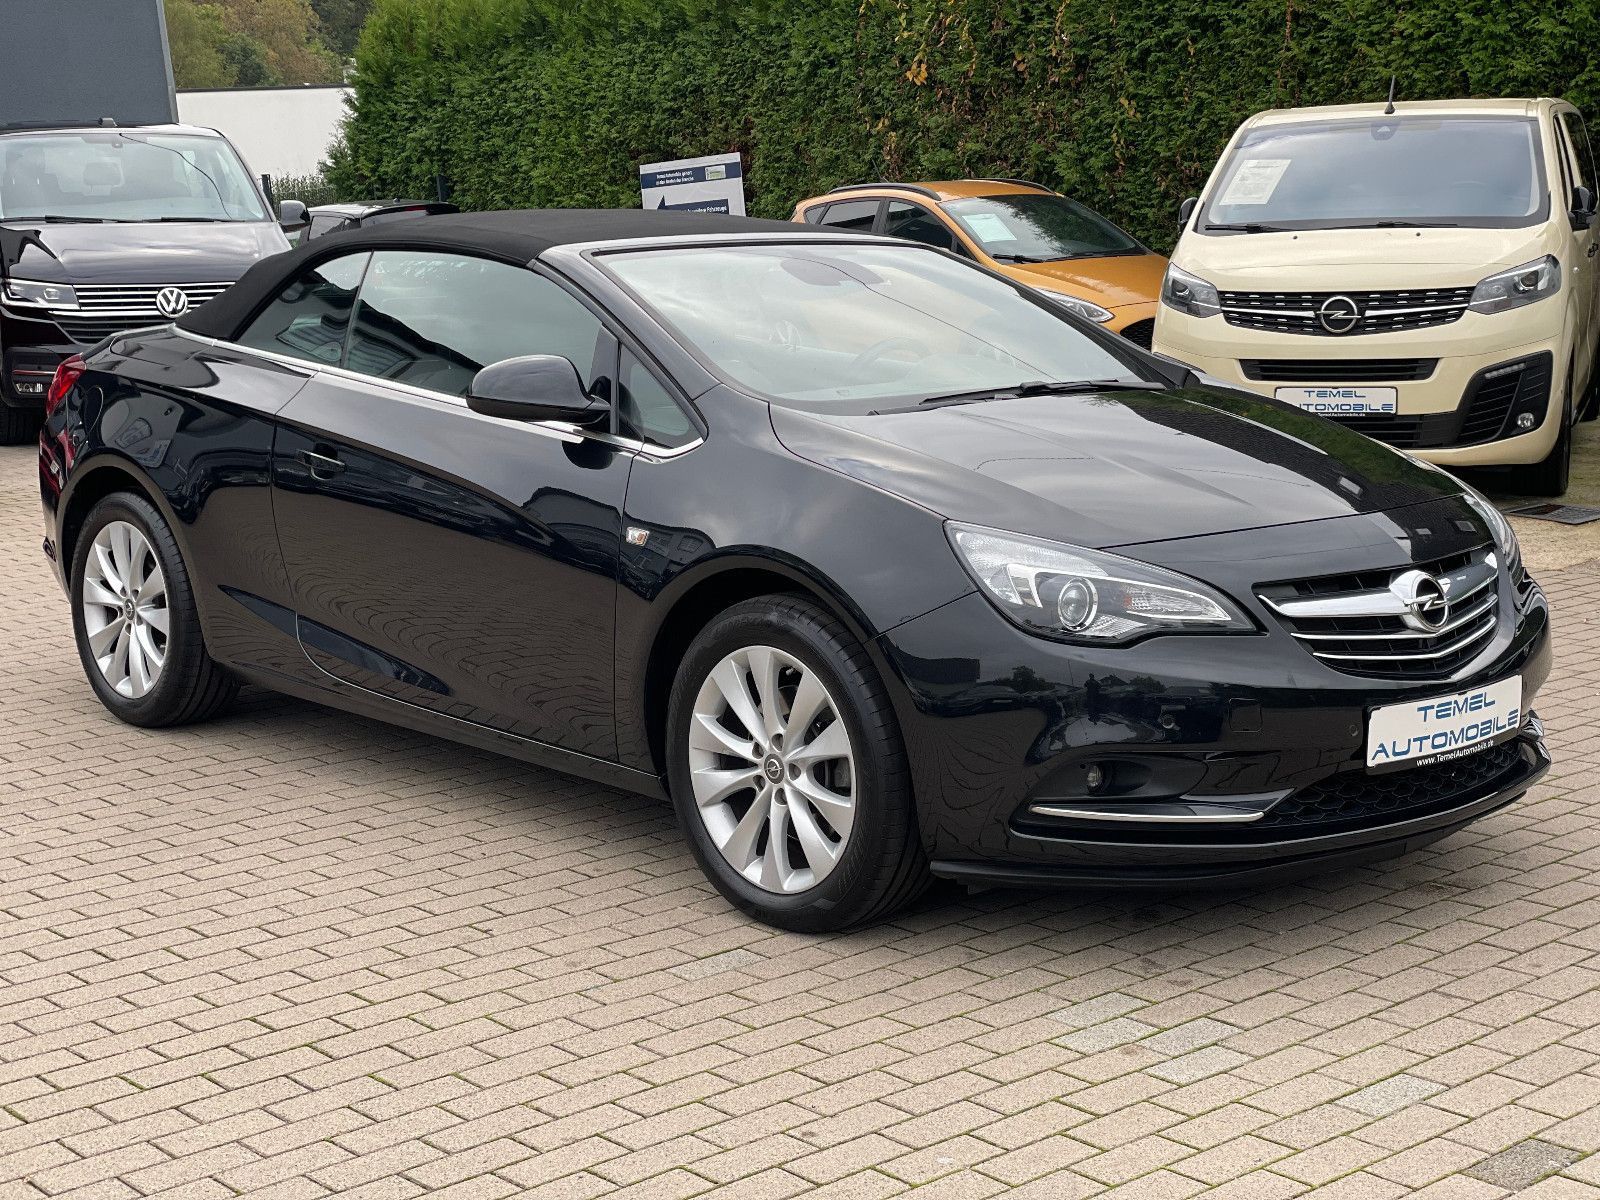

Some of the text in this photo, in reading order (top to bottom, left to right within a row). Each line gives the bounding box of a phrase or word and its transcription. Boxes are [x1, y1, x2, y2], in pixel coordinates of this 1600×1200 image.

[1299, 403, 1394, 412] TOMOBILE
[1303, 390, 1366, 398] TEMEL
[1416, 691, 1496, 723] TEMEL
[1371, 708, 1519, 761] AUTOMOBILE
[1416, 739, 1494, 767] www.TemelAutomobile.de
